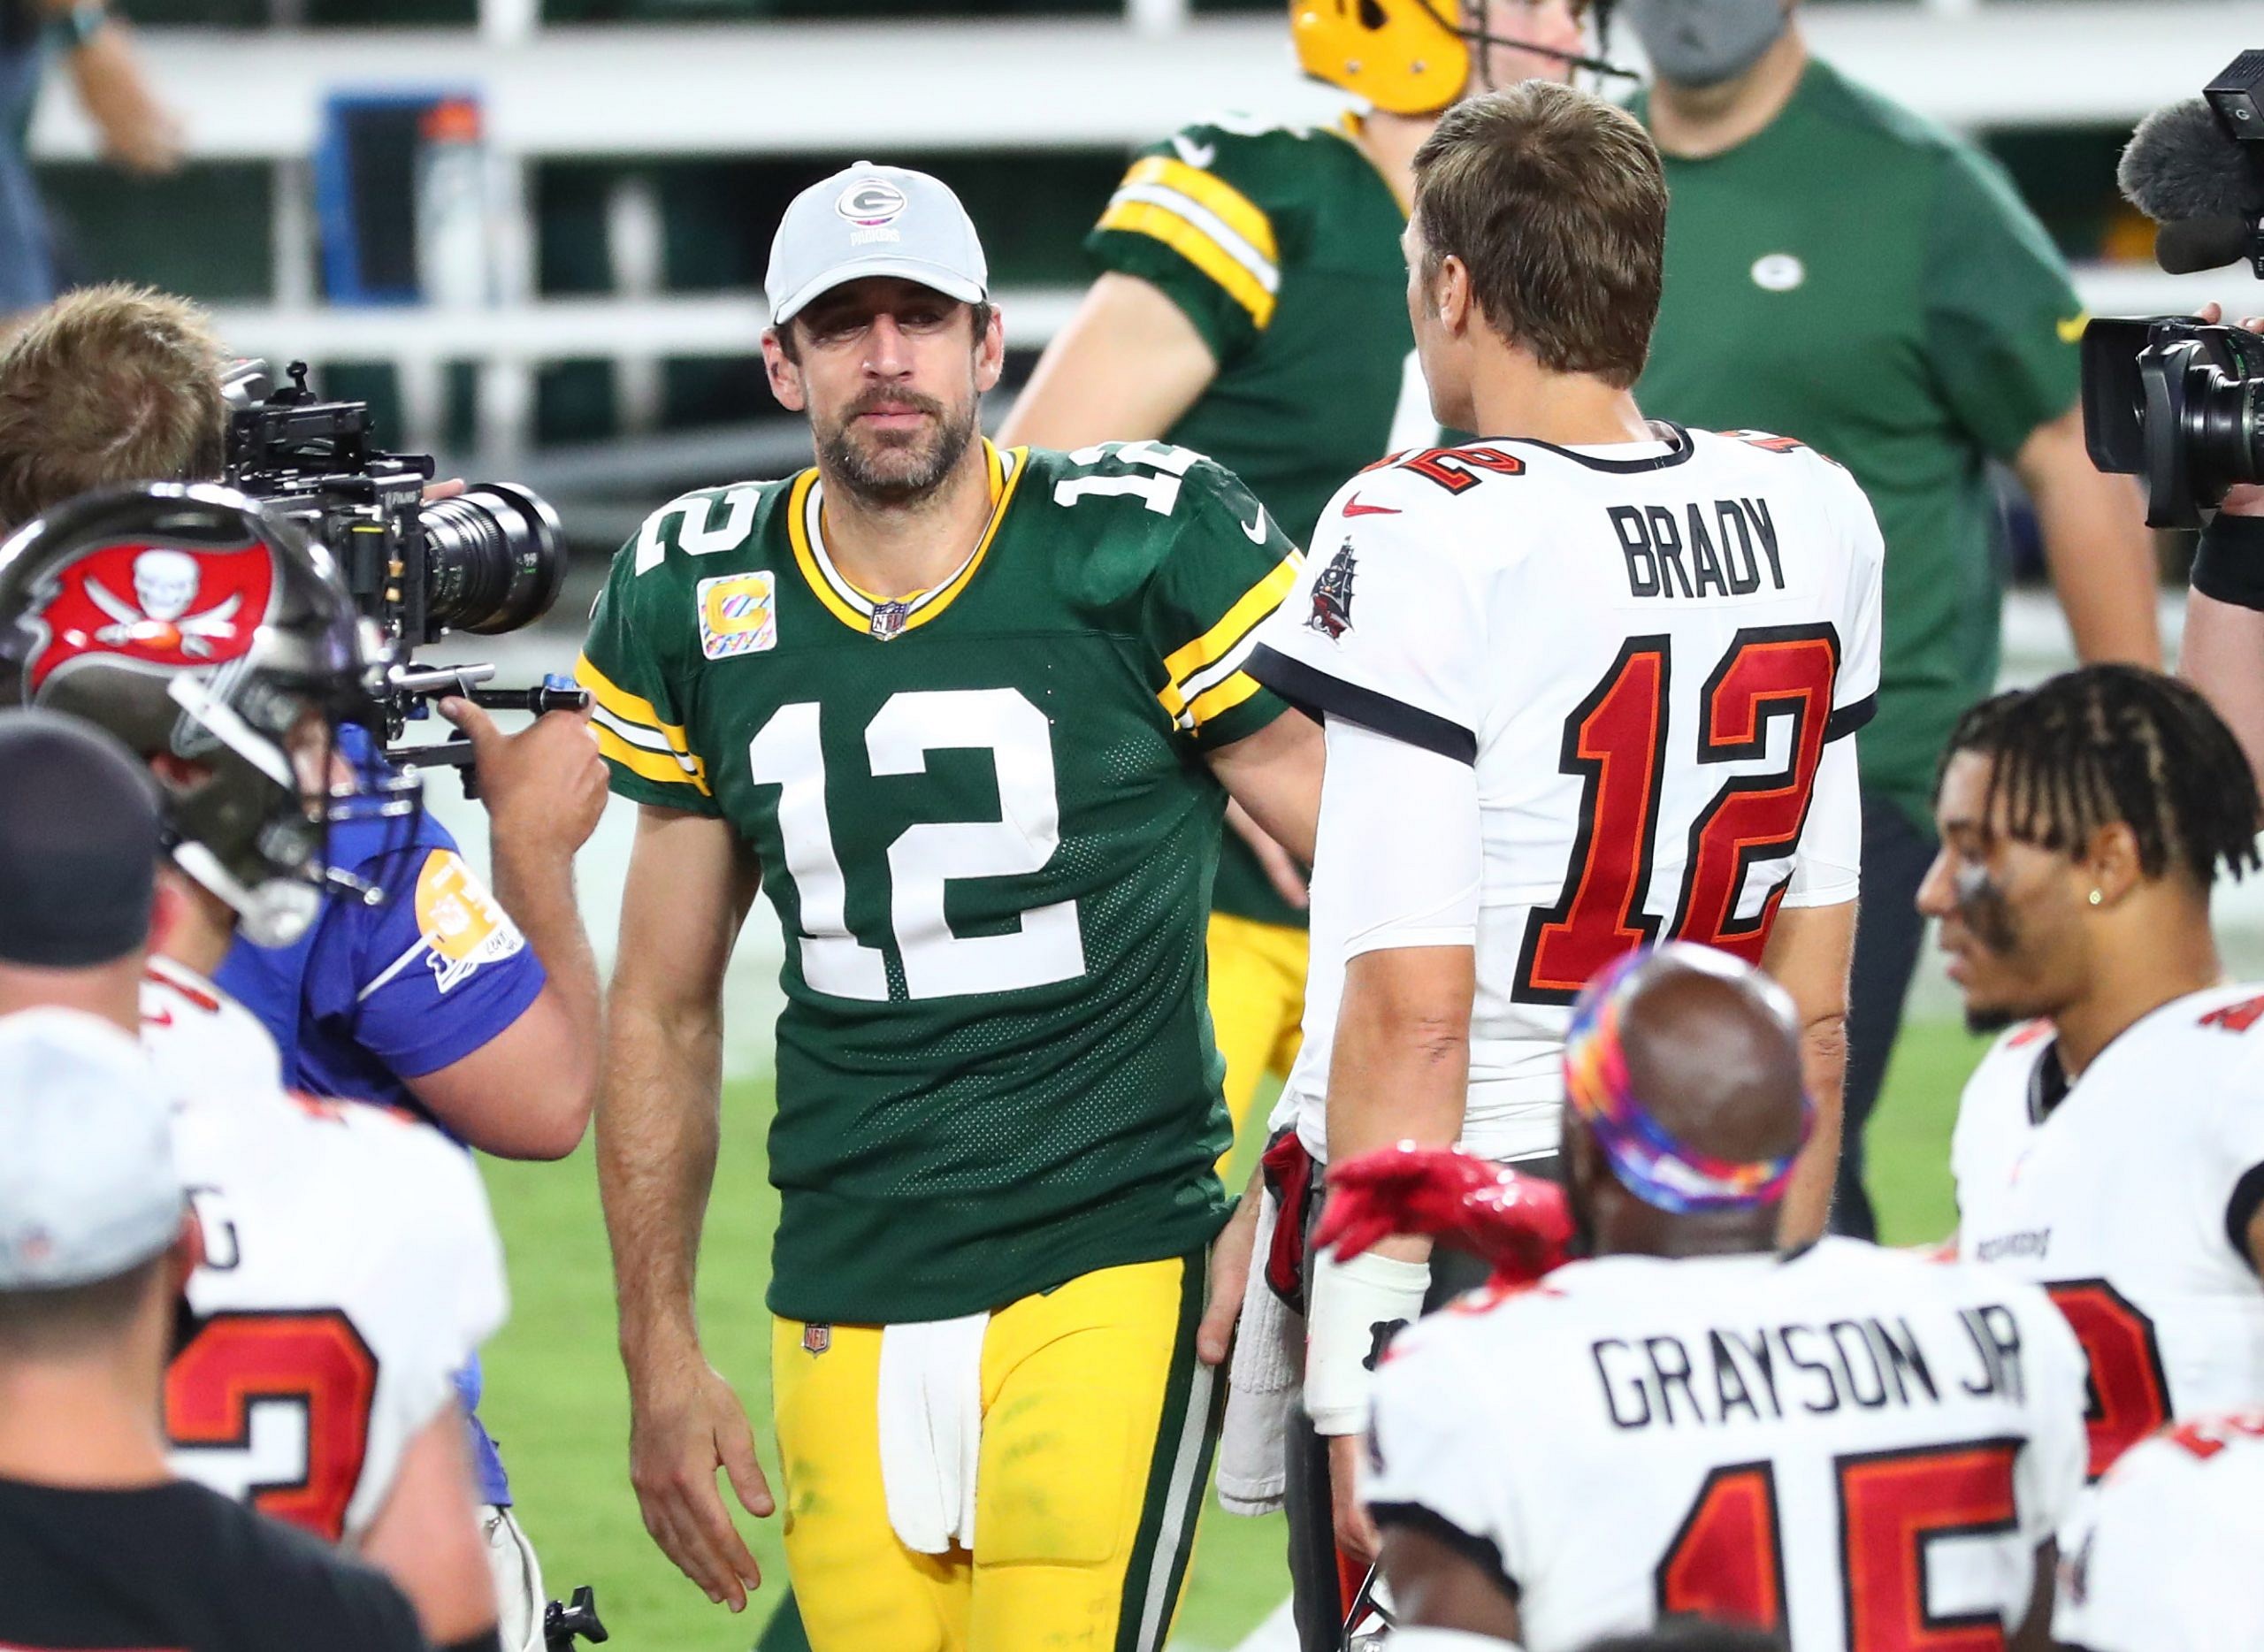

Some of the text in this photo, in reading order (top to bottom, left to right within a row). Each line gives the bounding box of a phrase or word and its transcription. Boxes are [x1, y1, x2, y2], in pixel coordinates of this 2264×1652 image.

[838, 183, 904, 218] G
[1052, 440, 1211, 516] 12
[1606, 497, 1786, 598] BRADY
[706, 578, 769, 634] C
[872, 614, 902, 633] NFL
[749, 687, 1086, 1001] 12
[1511, 621, 1841, 1005] 12
[806, 1328, 828, 1349] NFL
[1592, 1318, 1940, 1429] GRAYSON
[1957, 1304, 2026, 1406] JR
